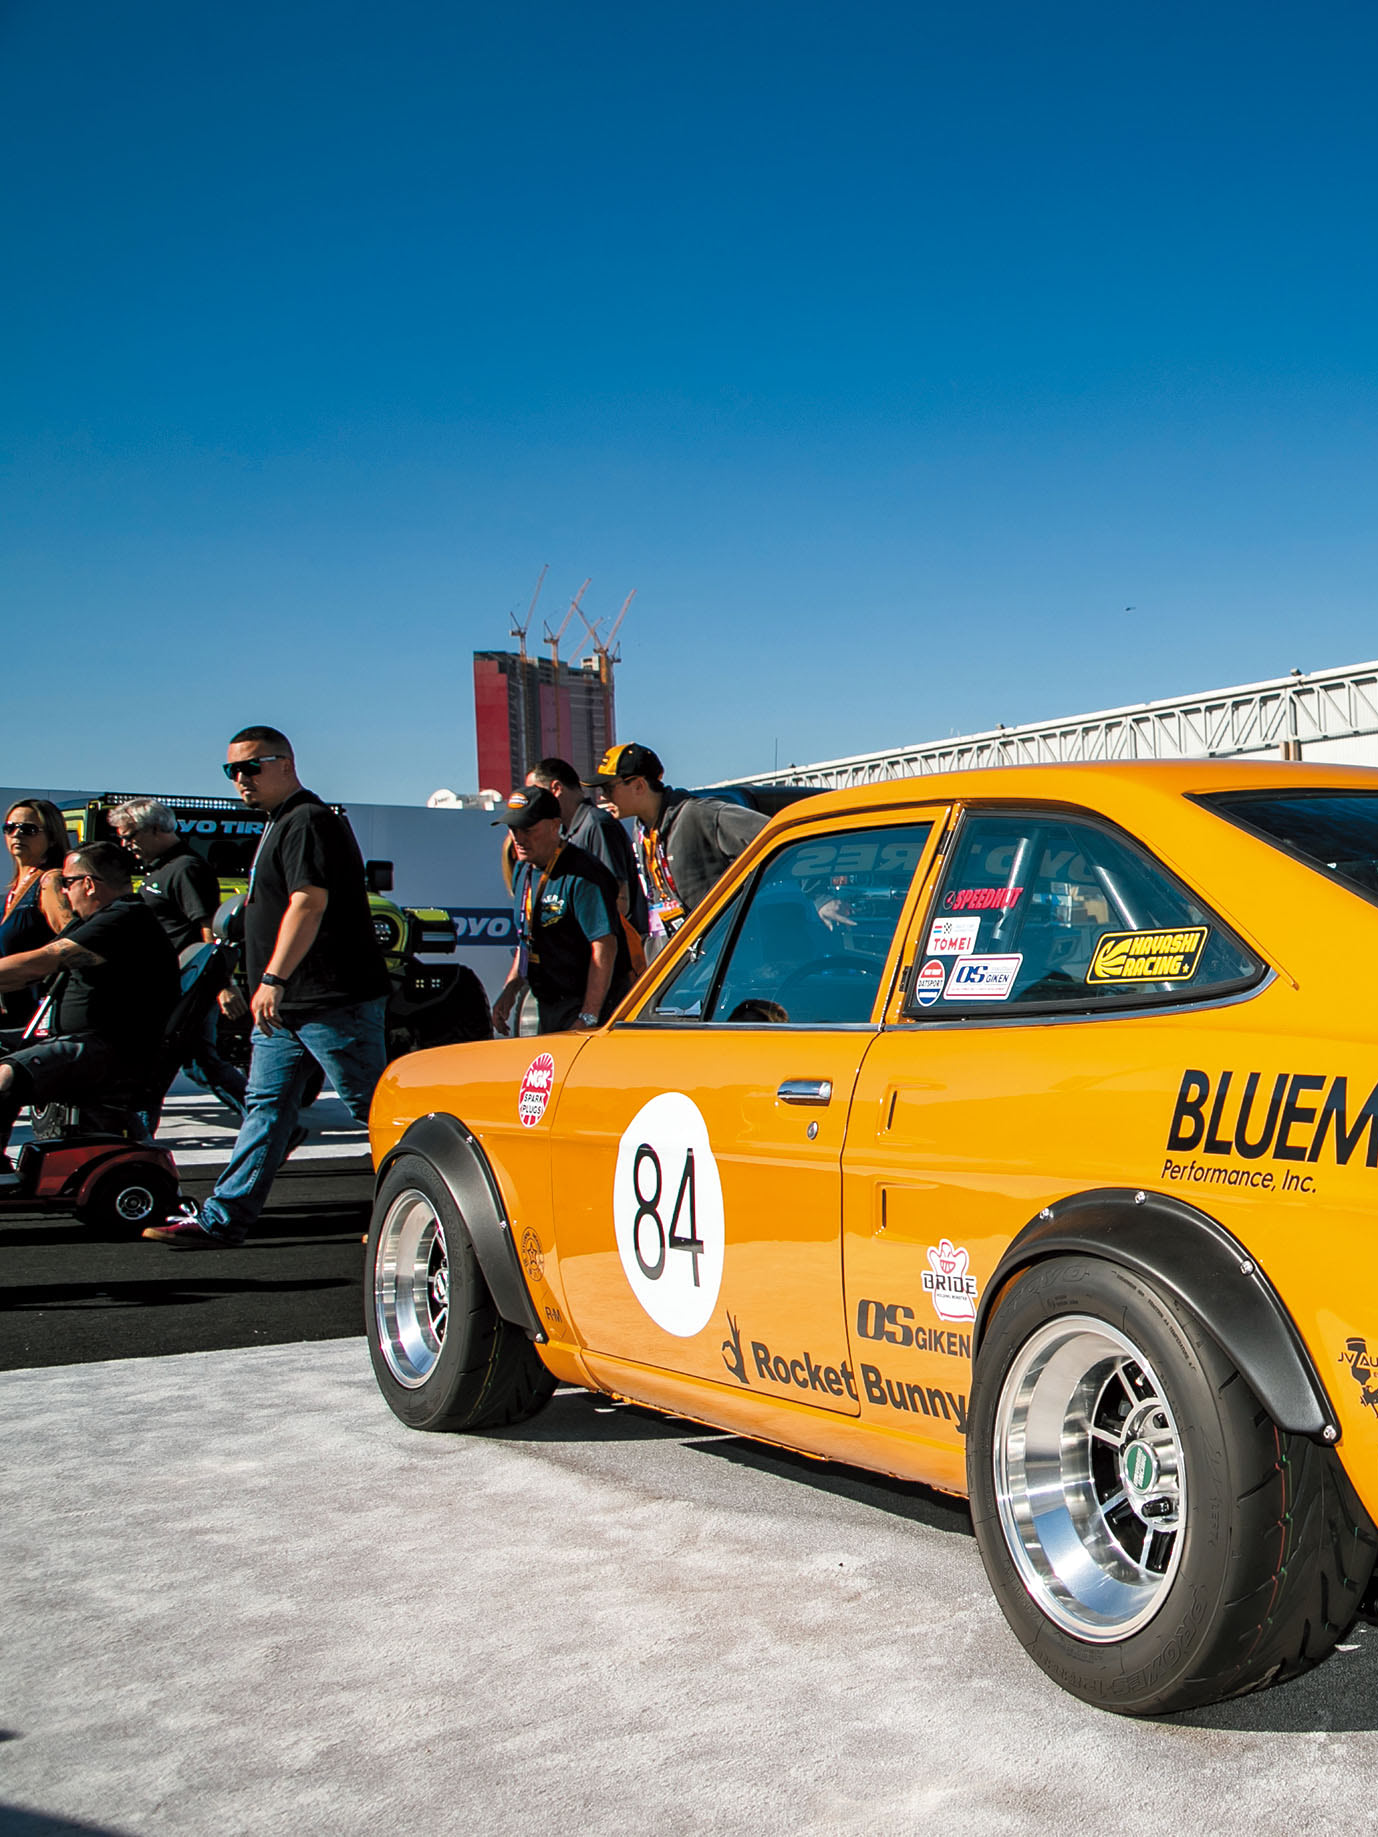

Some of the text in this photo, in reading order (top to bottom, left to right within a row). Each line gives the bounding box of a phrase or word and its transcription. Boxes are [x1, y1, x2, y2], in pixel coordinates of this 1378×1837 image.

[174, 819, 264, 834] YO TIR
[952, 887, 1024, 911] SPEEDHUT
[934, 937, 971, 951] TOMEI
[1128, 932, 1201, 956] HAYASHI
[1121, 955, 1184, 977] RACING
[985, 974, 1009, 983] GIKEN
[526, 1069, 551, 1089] NGK
[524, 1093, 544, 1103] SPARK
[522, 1104, 542, 1115] PLUGS
[1161, 1159, 1317, 1193] Performance, Inc.
[633, 1143, 704, 1288] 84
[922, 1273, 978, 1295] BRIDE
[857, 1298, 971, 1359] OS GIKEN
[751, 1341, 969, 1434] Rocket Bunny
